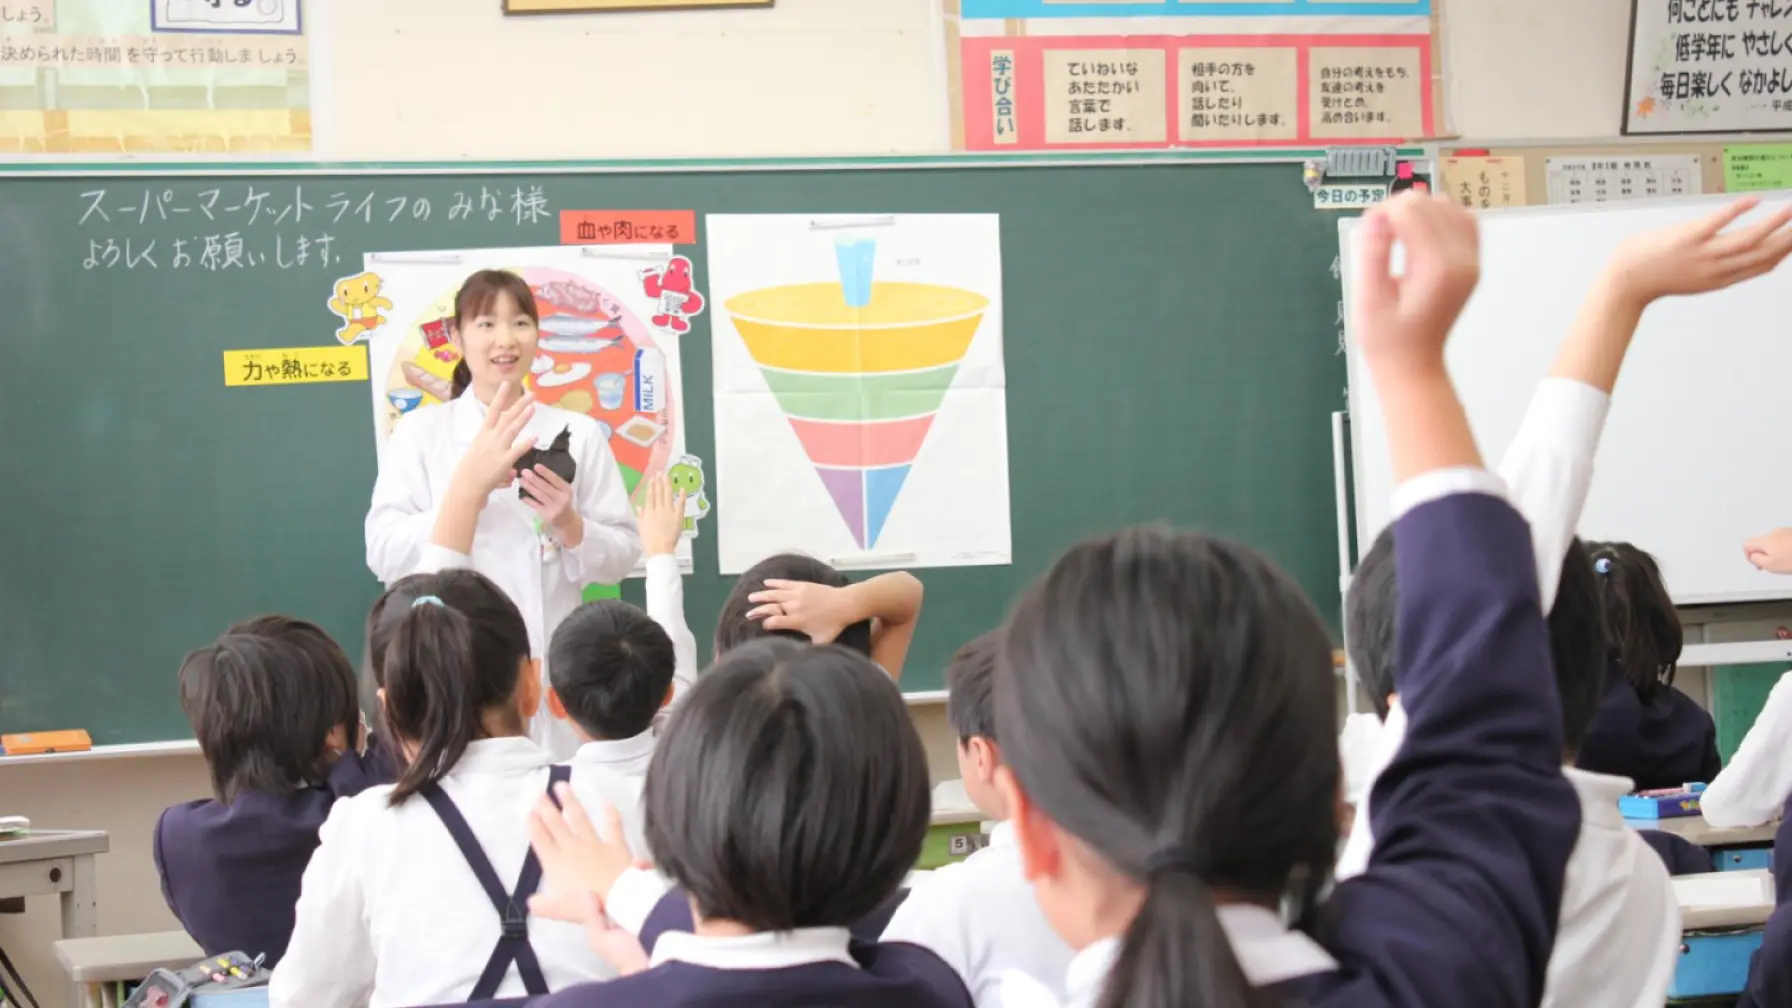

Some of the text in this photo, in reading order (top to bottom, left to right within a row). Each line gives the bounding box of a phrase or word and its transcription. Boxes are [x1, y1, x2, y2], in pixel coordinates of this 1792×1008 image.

[1676, 33, 1736, 61] 低学年に
[1067, 62, 1138, 76] ていねいな
[1191, 62, 1255, 77] 相手の方を
[1068, 81, 1140, 94] あたたかい
[1660, 67, 1792, 99] 毎日楽しく なかよし
[992, 55, 1014, 136] 学び合い
[1191, 96, 1242, 110] 話したり
[1068, 99, 1111, 114] 言葉で
[1068, 117, 1132, 133] 話します。
[1317, 188, 1384, 203] 今日の予定
[577, 220, 679, 240] 血や肉になる
[243, 359, 352, 381] 力や熱になる
[642, 375, 654, 410] MILK
